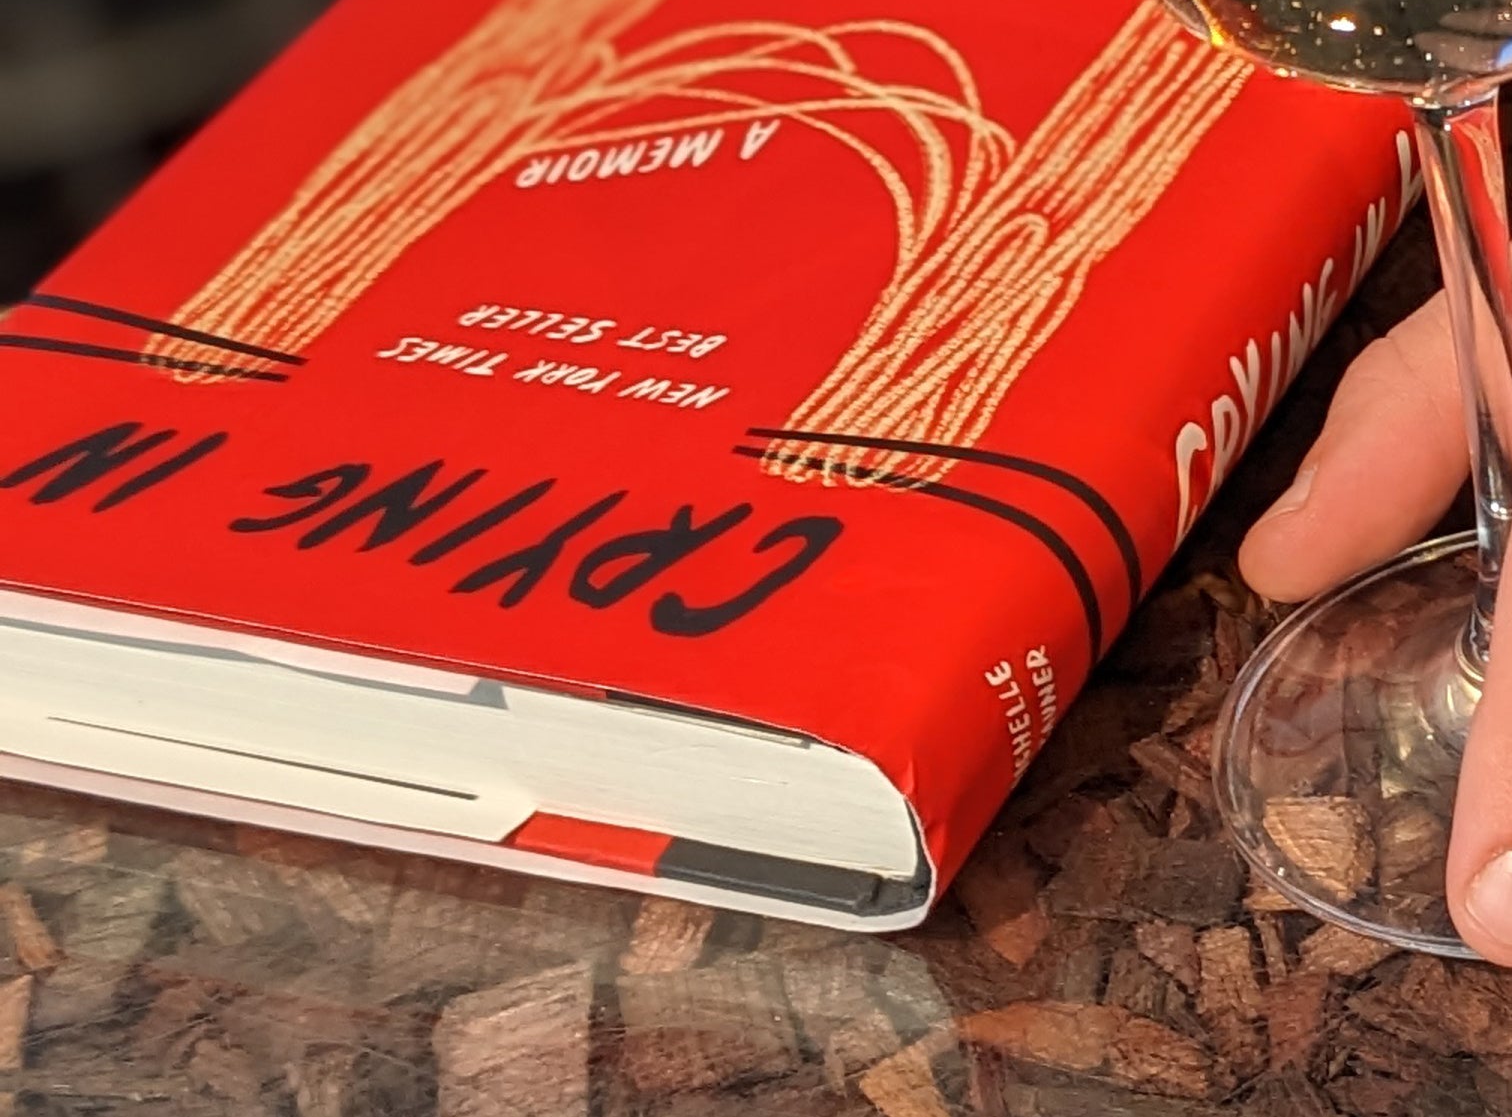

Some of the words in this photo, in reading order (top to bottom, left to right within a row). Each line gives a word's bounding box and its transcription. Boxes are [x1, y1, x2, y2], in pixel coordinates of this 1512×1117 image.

[515, 128, 724, 188] MEMOIR
[740, 120, 780, 160] A
[457, 304, 617, 344] SELLER
[616, 326, 728, 359] BEST
[375, 337, 509, 376] TIMES
[513, 359, 621, 394] YORK
[617, 378, 730, 409] NEW
[0, 420, 229, 513] IN
[228, 457, 845, 638] CRYING
